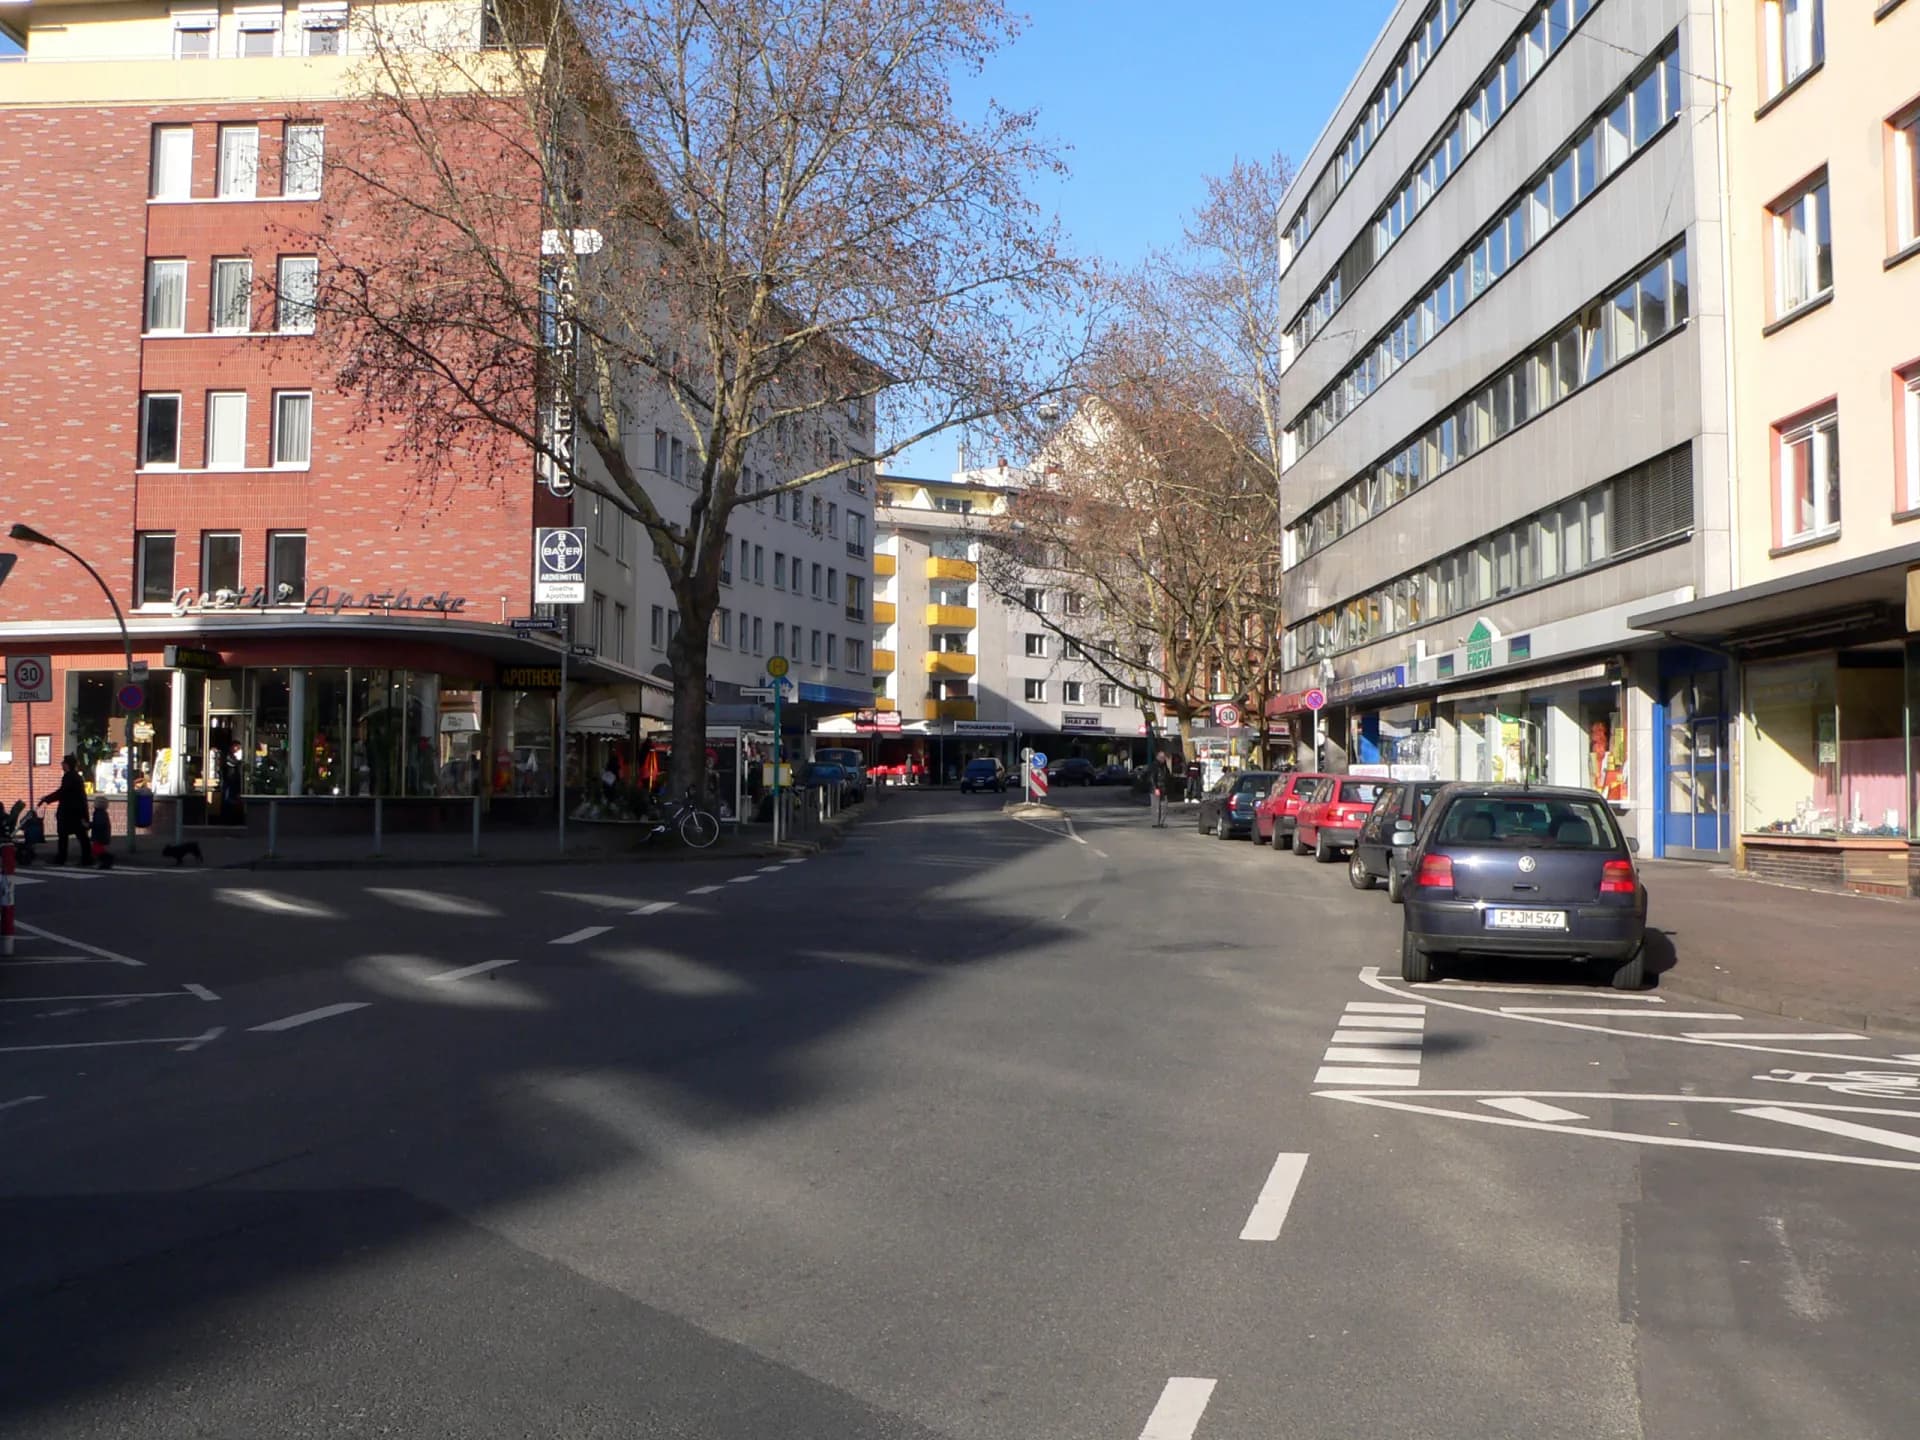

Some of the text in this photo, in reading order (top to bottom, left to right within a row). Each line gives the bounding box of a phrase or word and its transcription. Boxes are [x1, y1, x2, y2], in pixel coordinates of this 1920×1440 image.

[543, 547, 580, 556] BAYER
[20, 667, 38, 682] 30
[503, 667, 562, 687] APOTHEKE
[1222, 710, 1235, 721] 30
[1500, 911, 1560, 925] F JM 547
